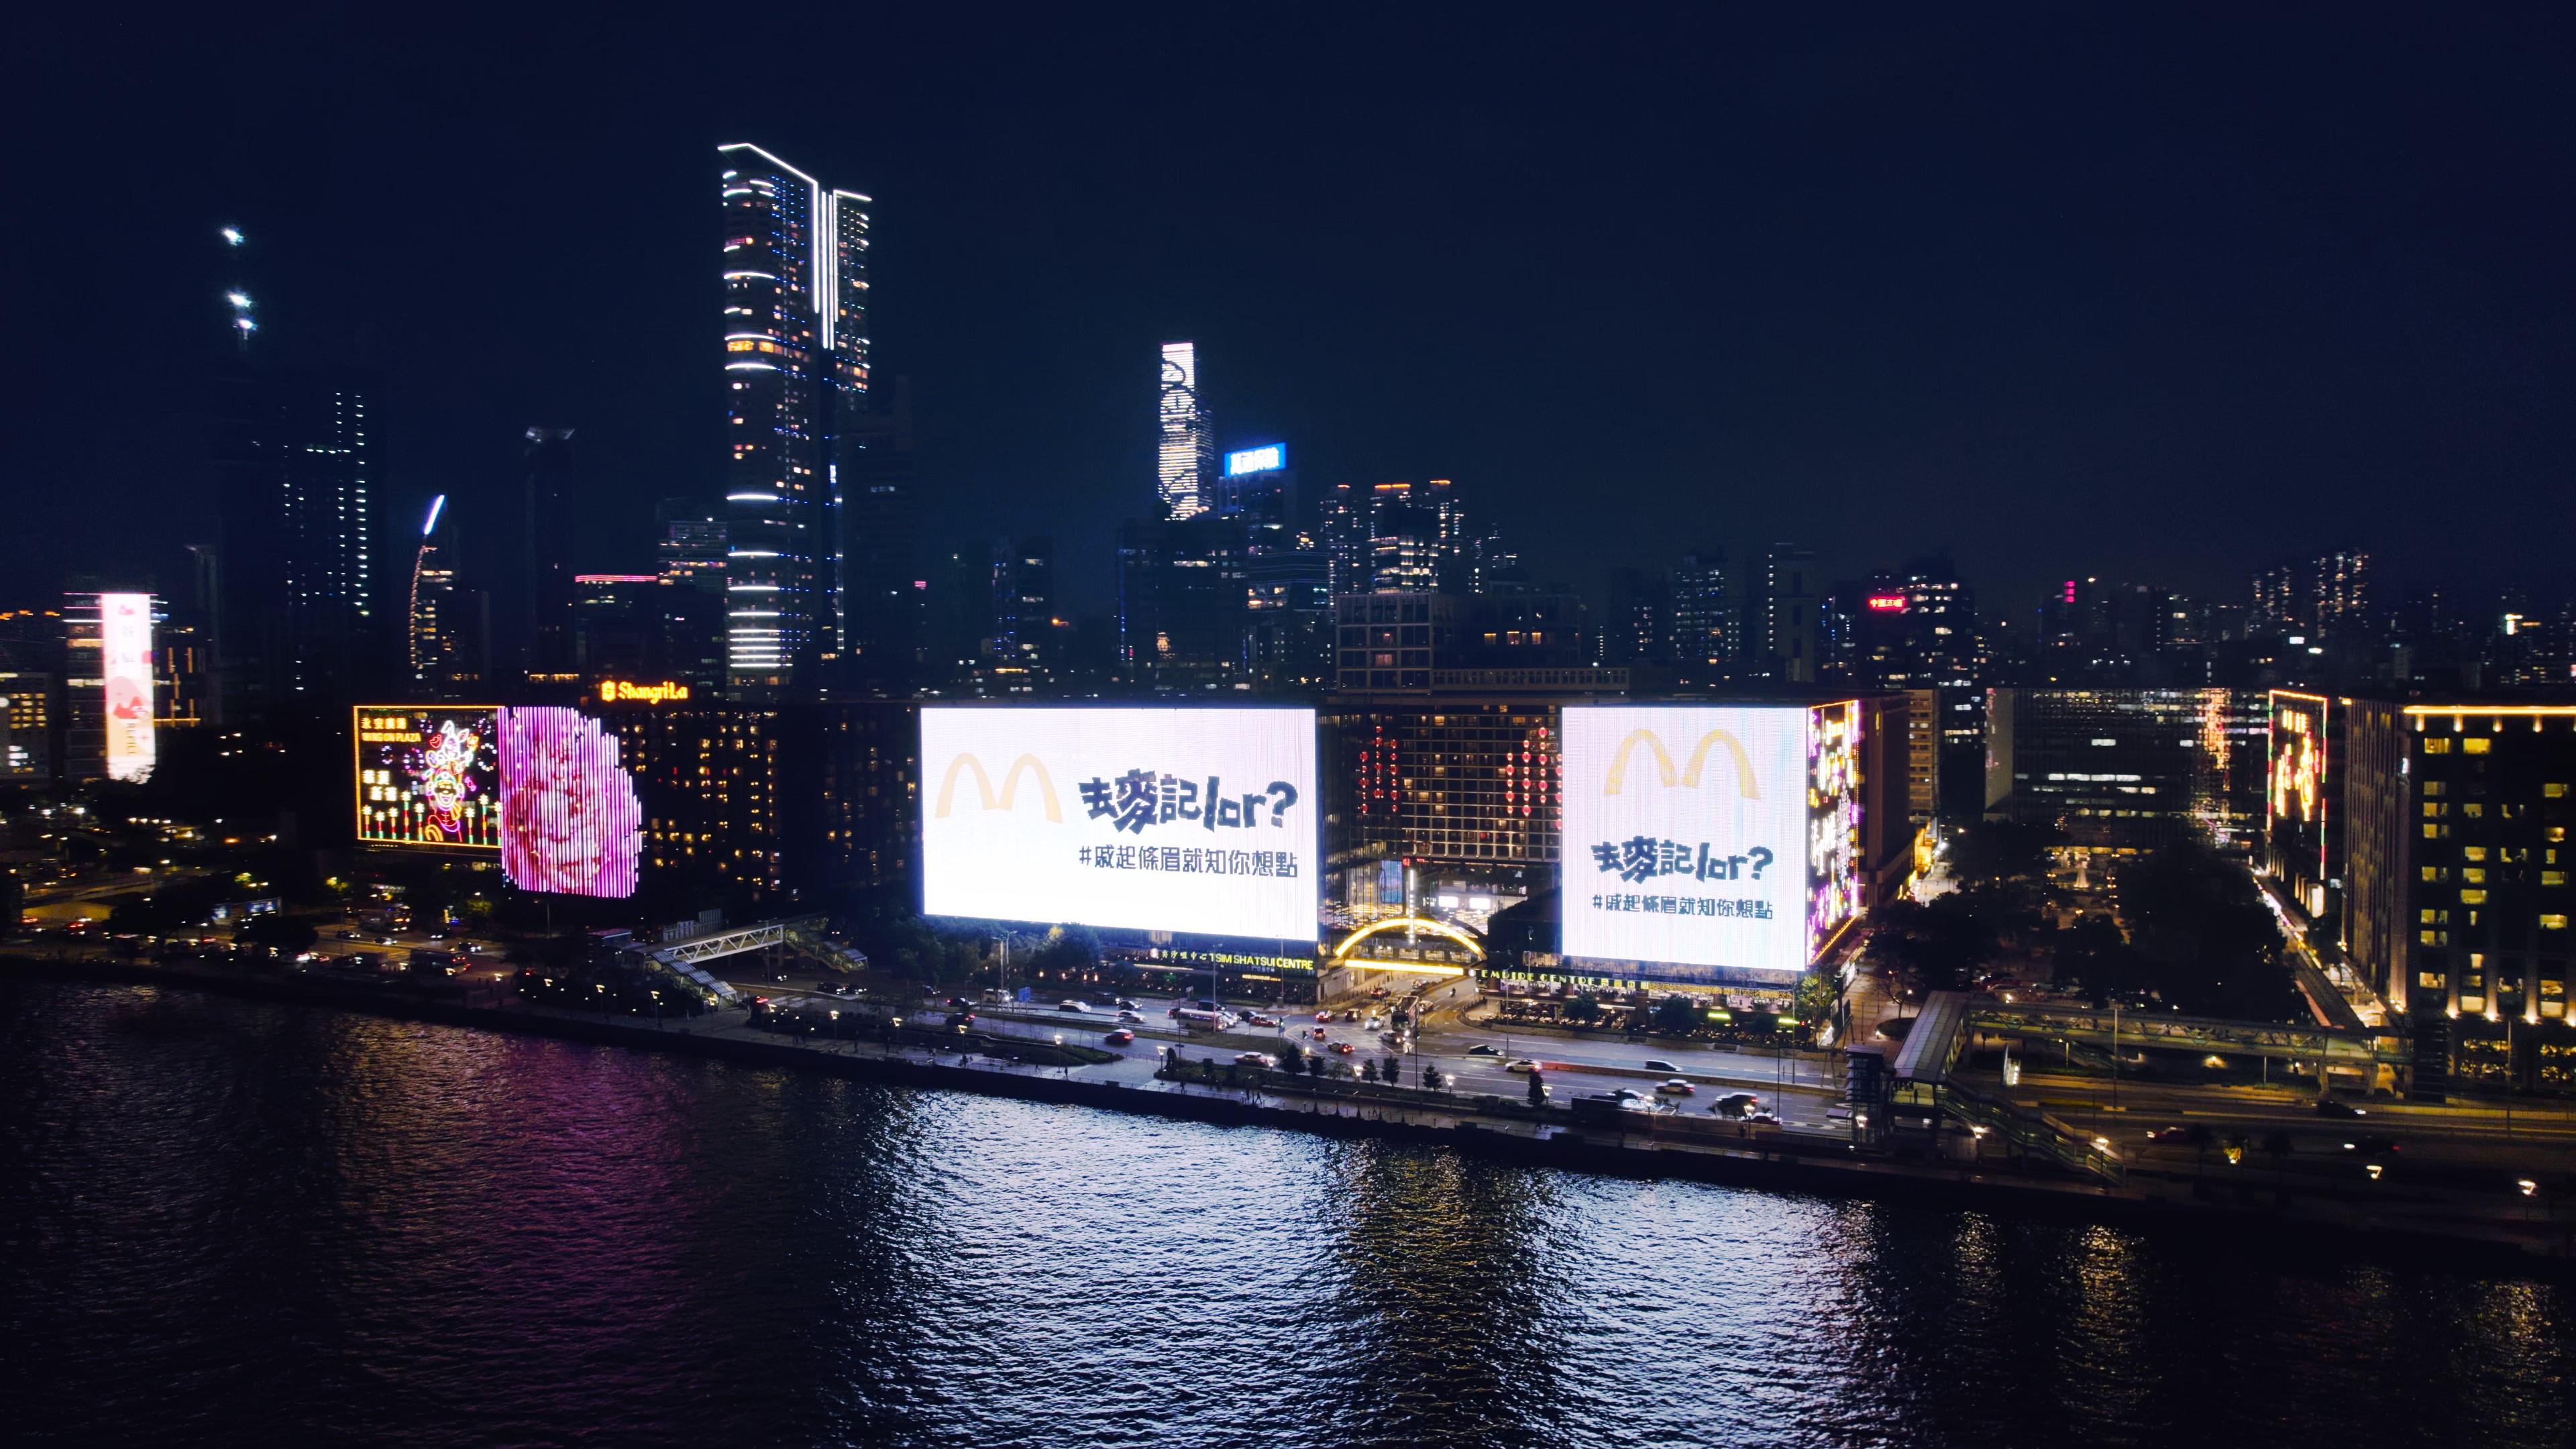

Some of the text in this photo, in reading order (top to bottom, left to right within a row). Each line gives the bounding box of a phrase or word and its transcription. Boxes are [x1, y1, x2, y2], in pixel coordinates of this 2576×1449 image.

[396, 733, 421, 742] PLAZA
[1209, 953, 1232, 964] TSIM
[1233, 955, 1254, 965] SHA
[1254, 956, 1276, 967] TSUI
[1277, 957, 1314, 970] CENTRE
[1481, 969, 1534, 981] EMPIRE
[1540, 973, 1595, 985] CENTRE
